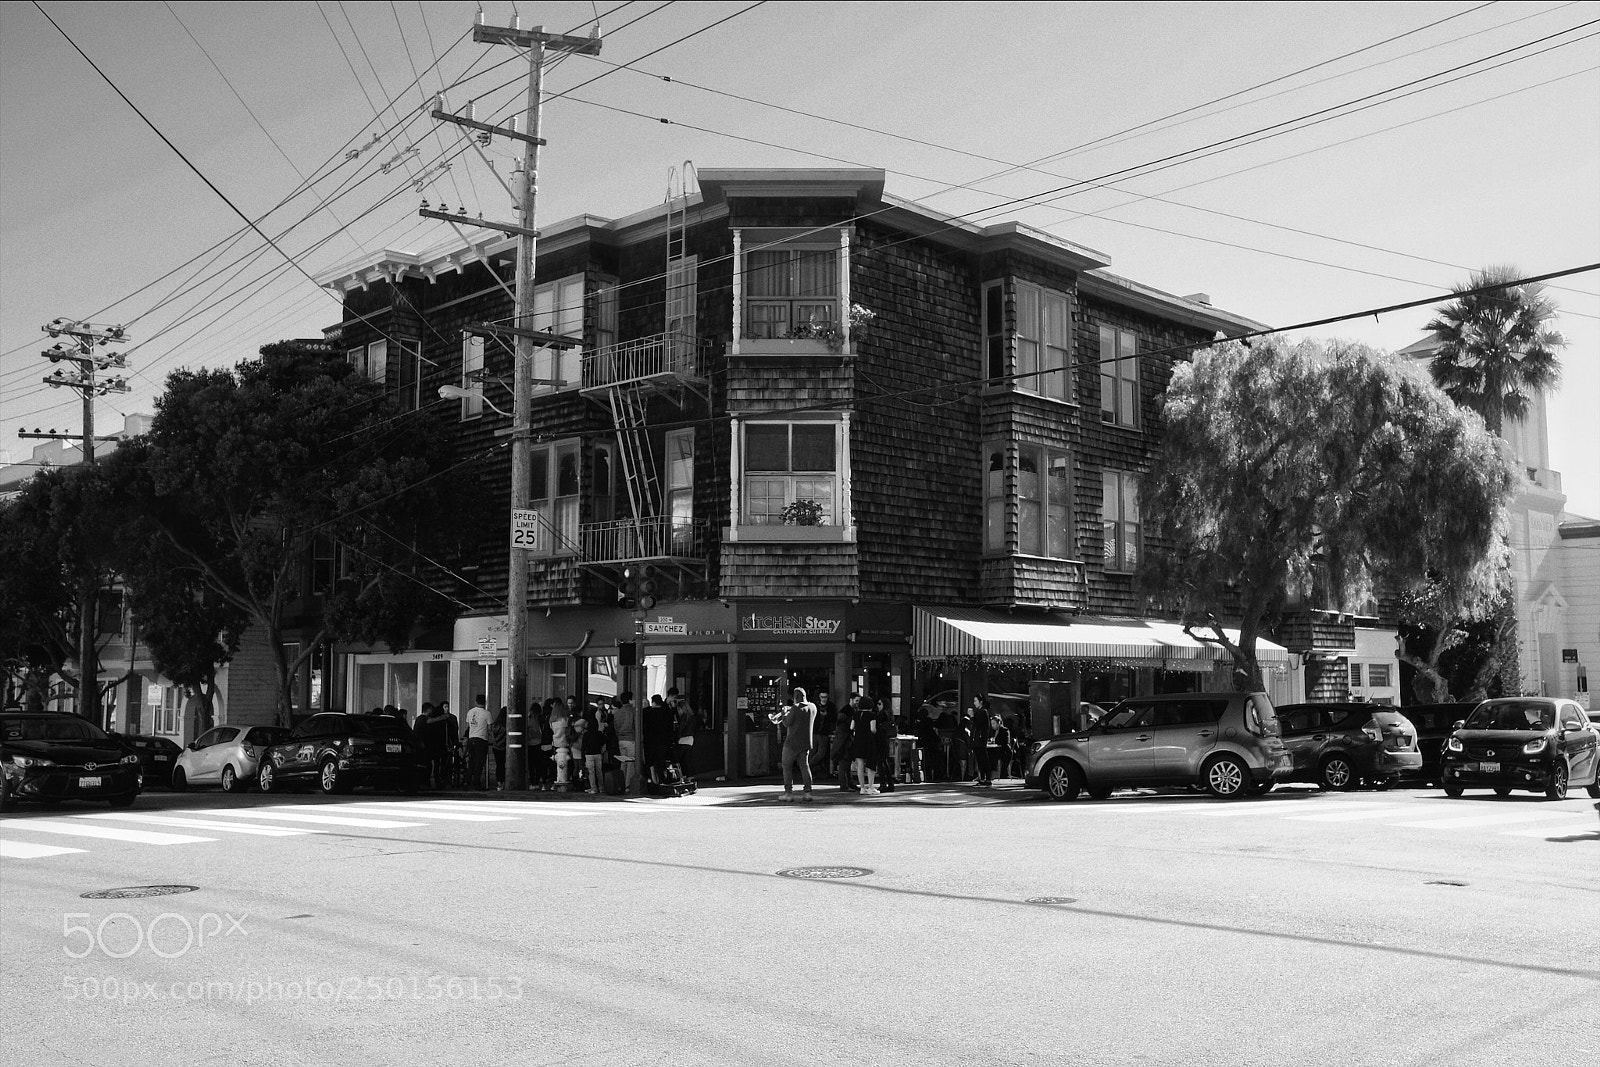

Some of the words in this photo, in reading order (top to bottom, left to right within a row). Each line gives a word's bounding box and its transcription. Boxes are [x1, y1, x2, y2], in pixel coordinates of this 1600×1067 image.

[514, 513, 537, 521] SPEED
[515, 530, 535, 544] 25
[648, 624, 683, 633] SANCHEZ
[742, 613, 802, 629] KITCHEN
[805, 616, 840, 633] Story
